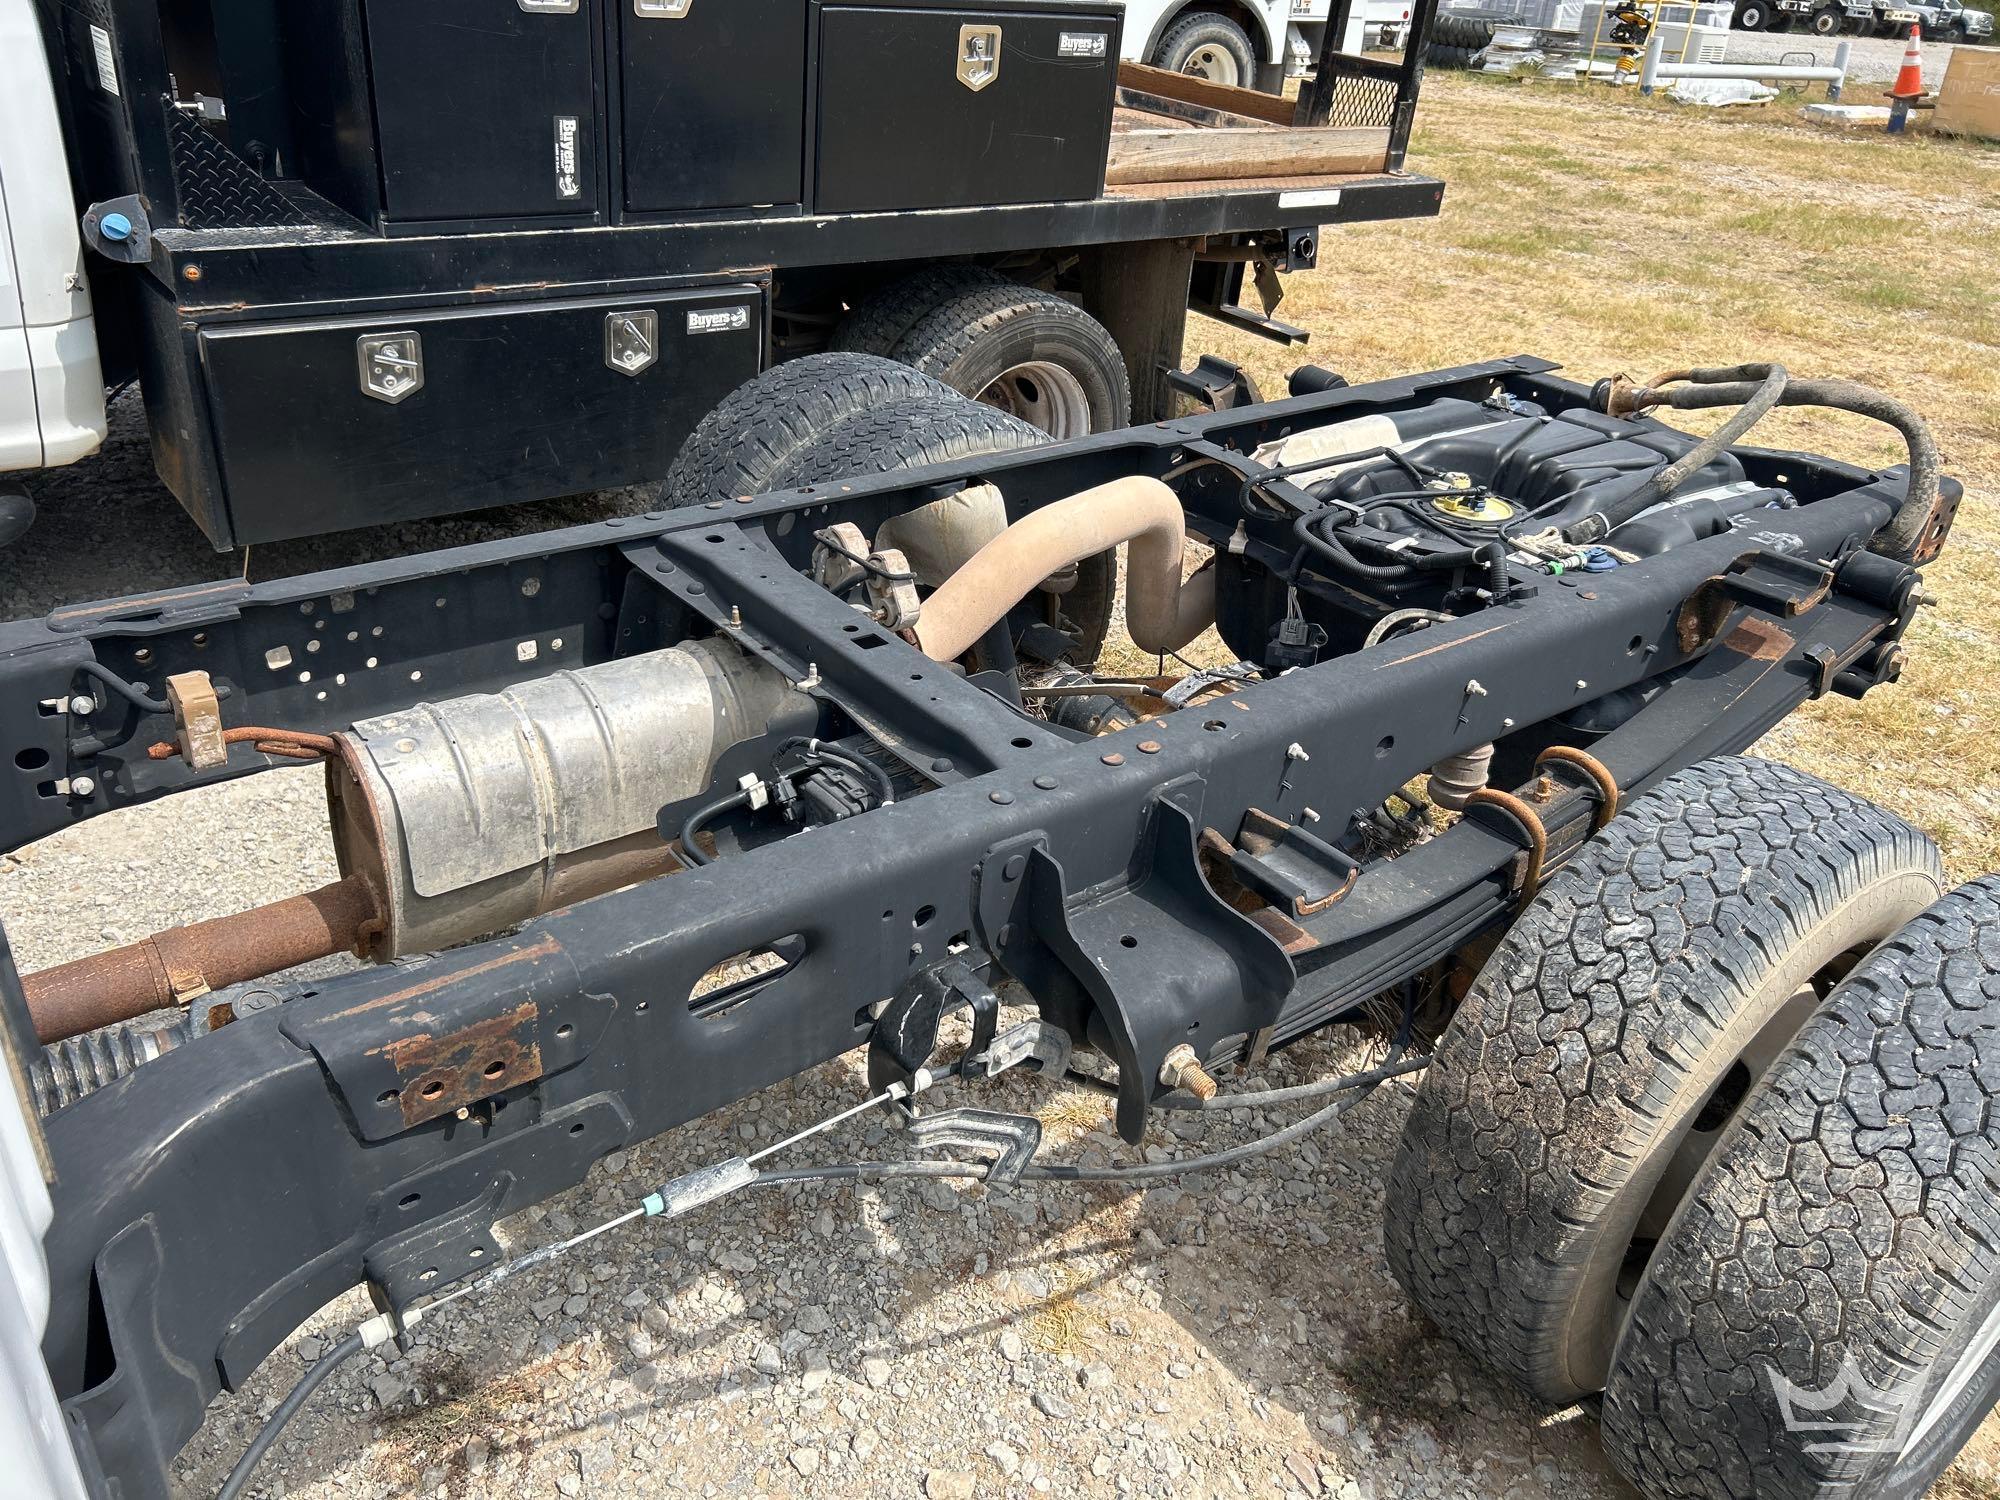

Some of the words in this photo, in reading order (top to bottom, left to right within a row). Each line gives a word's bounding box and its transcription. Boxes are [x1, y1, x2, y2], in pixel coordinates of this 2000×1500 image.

[1060, 35, 1092, 52] Buyers
[560, 120, 576, 174] Buyers
[689, 313, 731, 328] Buyers
